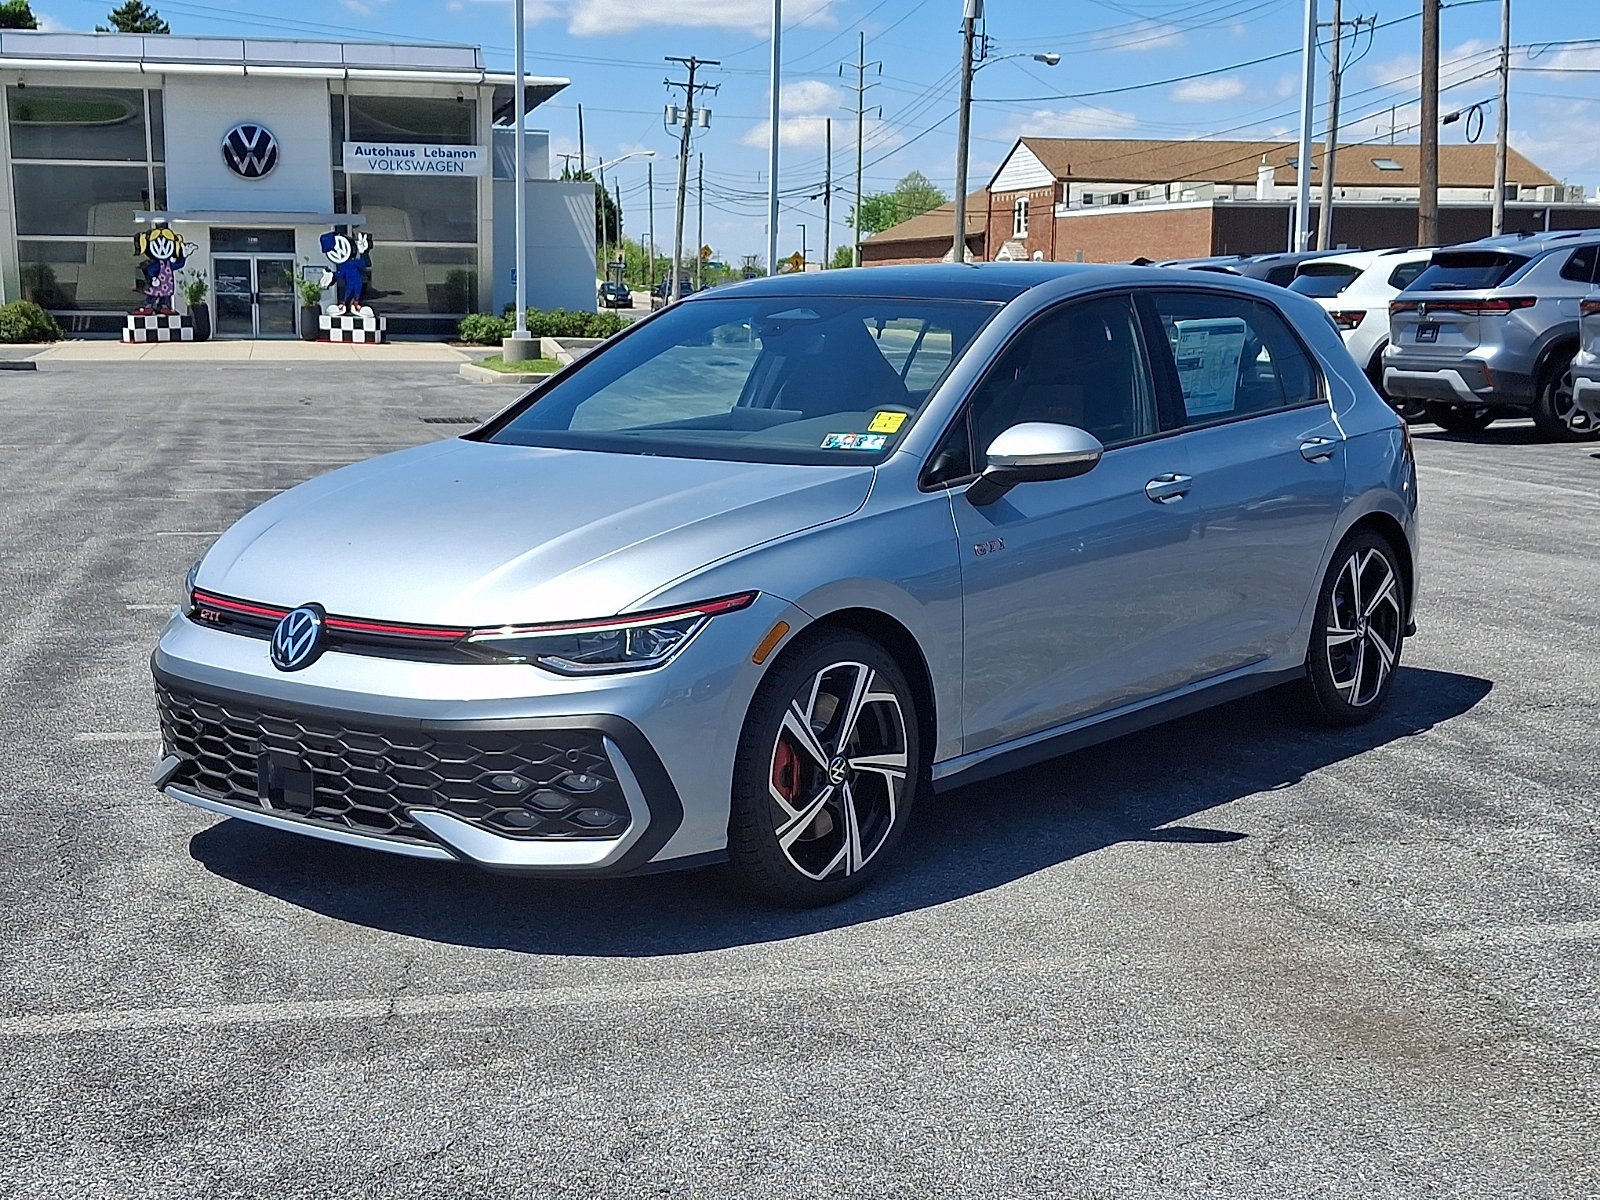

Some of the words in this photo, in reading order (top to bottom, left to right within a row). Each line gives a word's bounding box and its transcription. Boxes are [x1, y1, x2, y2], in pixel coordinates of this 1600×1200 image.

[355, 146, 415, 157] Autohaus
[424, 147, 477, 159] Lebanon
[368, 159, 464, 172] VOLKSWAGEN
[200, 608, 221, 622] GTI
